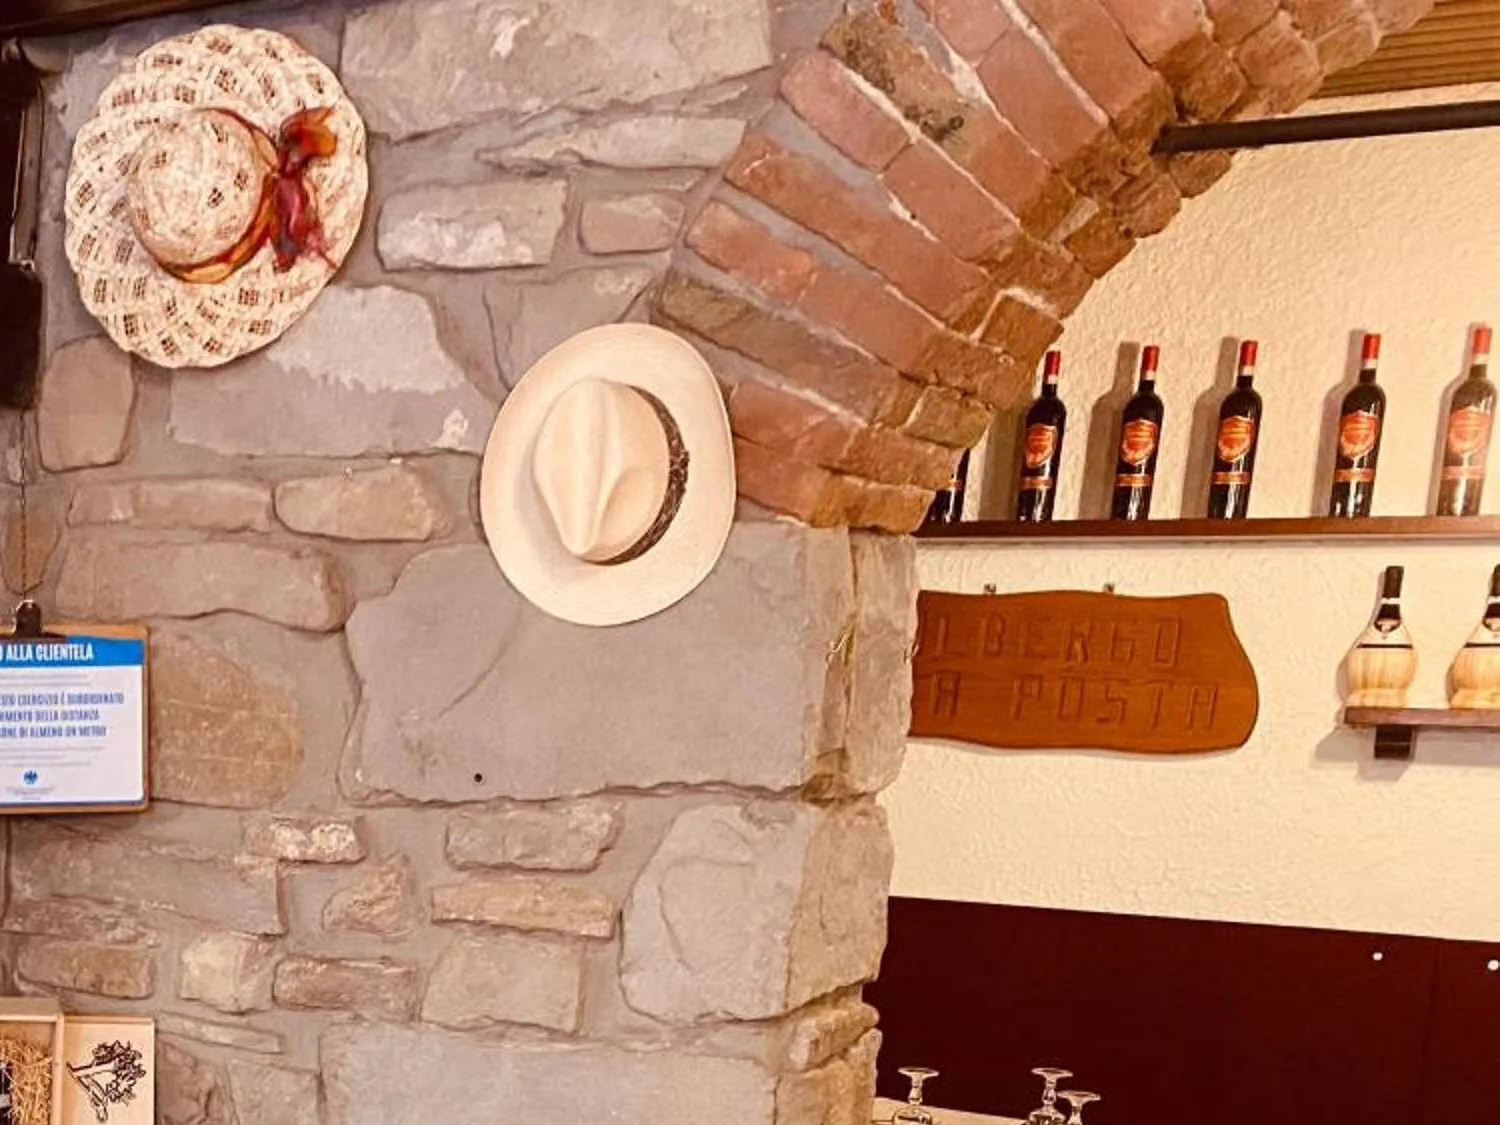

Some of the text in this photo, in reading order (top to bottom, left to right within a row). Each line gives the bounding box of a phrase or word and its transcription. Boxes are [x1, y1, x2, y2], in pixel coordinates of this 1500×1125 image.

[5, 644, 33, 662] ALLA
[35, 641, 94, 661] CLIENTELA
[932, 612, 1182, 668] LBERGO
[1012, 674, 1219, 735] POSTA
